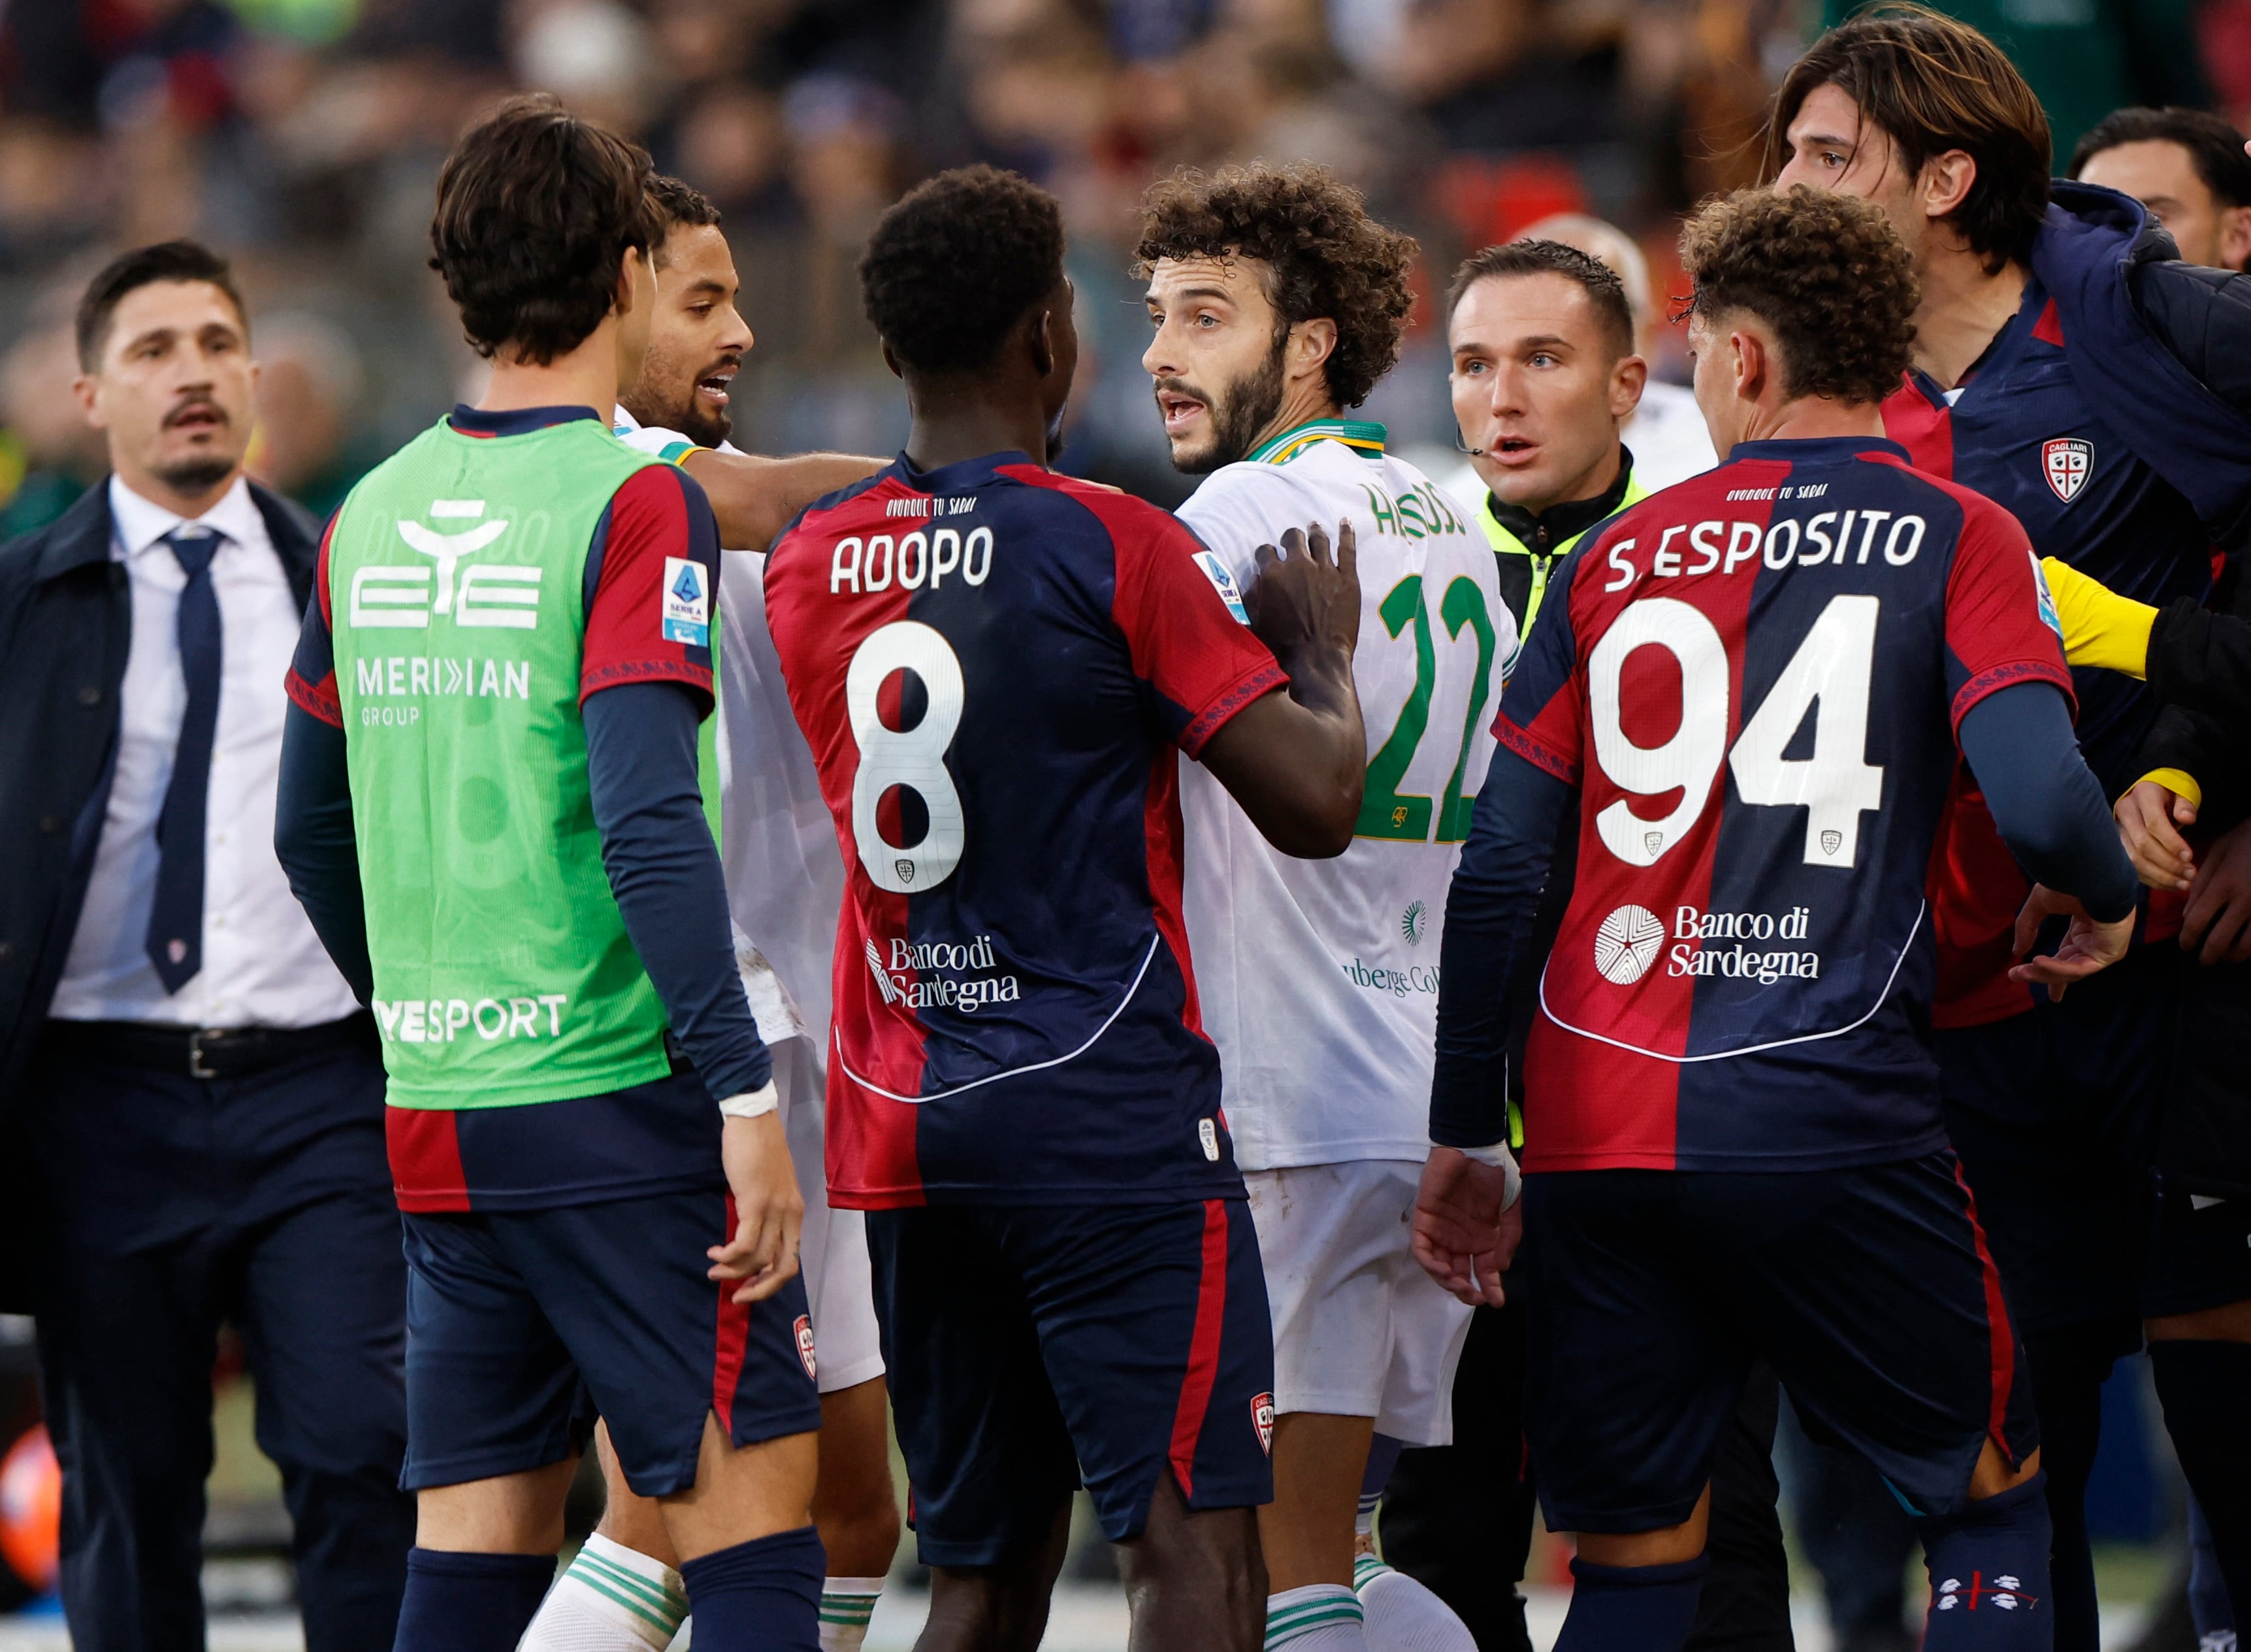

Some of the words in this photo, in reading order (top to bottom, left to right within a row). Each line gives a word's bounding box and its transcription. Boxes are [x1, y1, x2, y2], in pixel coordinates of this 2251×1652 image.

[2049, 443, 2088, 453] CAGLIARI
[933, 498, 945, 517] TU
[1779, 487, 1794, 500] TU
[830, 526, 994, 593] ADOPO
[361, 706, 419, 726] GROUP
[1354, 573, 1497, 844] 22
[1588, 594, 1884, 868] 94
[846, 620, 965, 894] 8
[1672, 905, 1774, 941] Banco
[1779, 906, 1809, 939] di
[1342, 958, 1412, 998] uberge
[1668, 944, 1819, 985] Sardegna
[890, 973, 1021, 1012] Sardegna
[372, 994, 567, 1043] YESPORT
